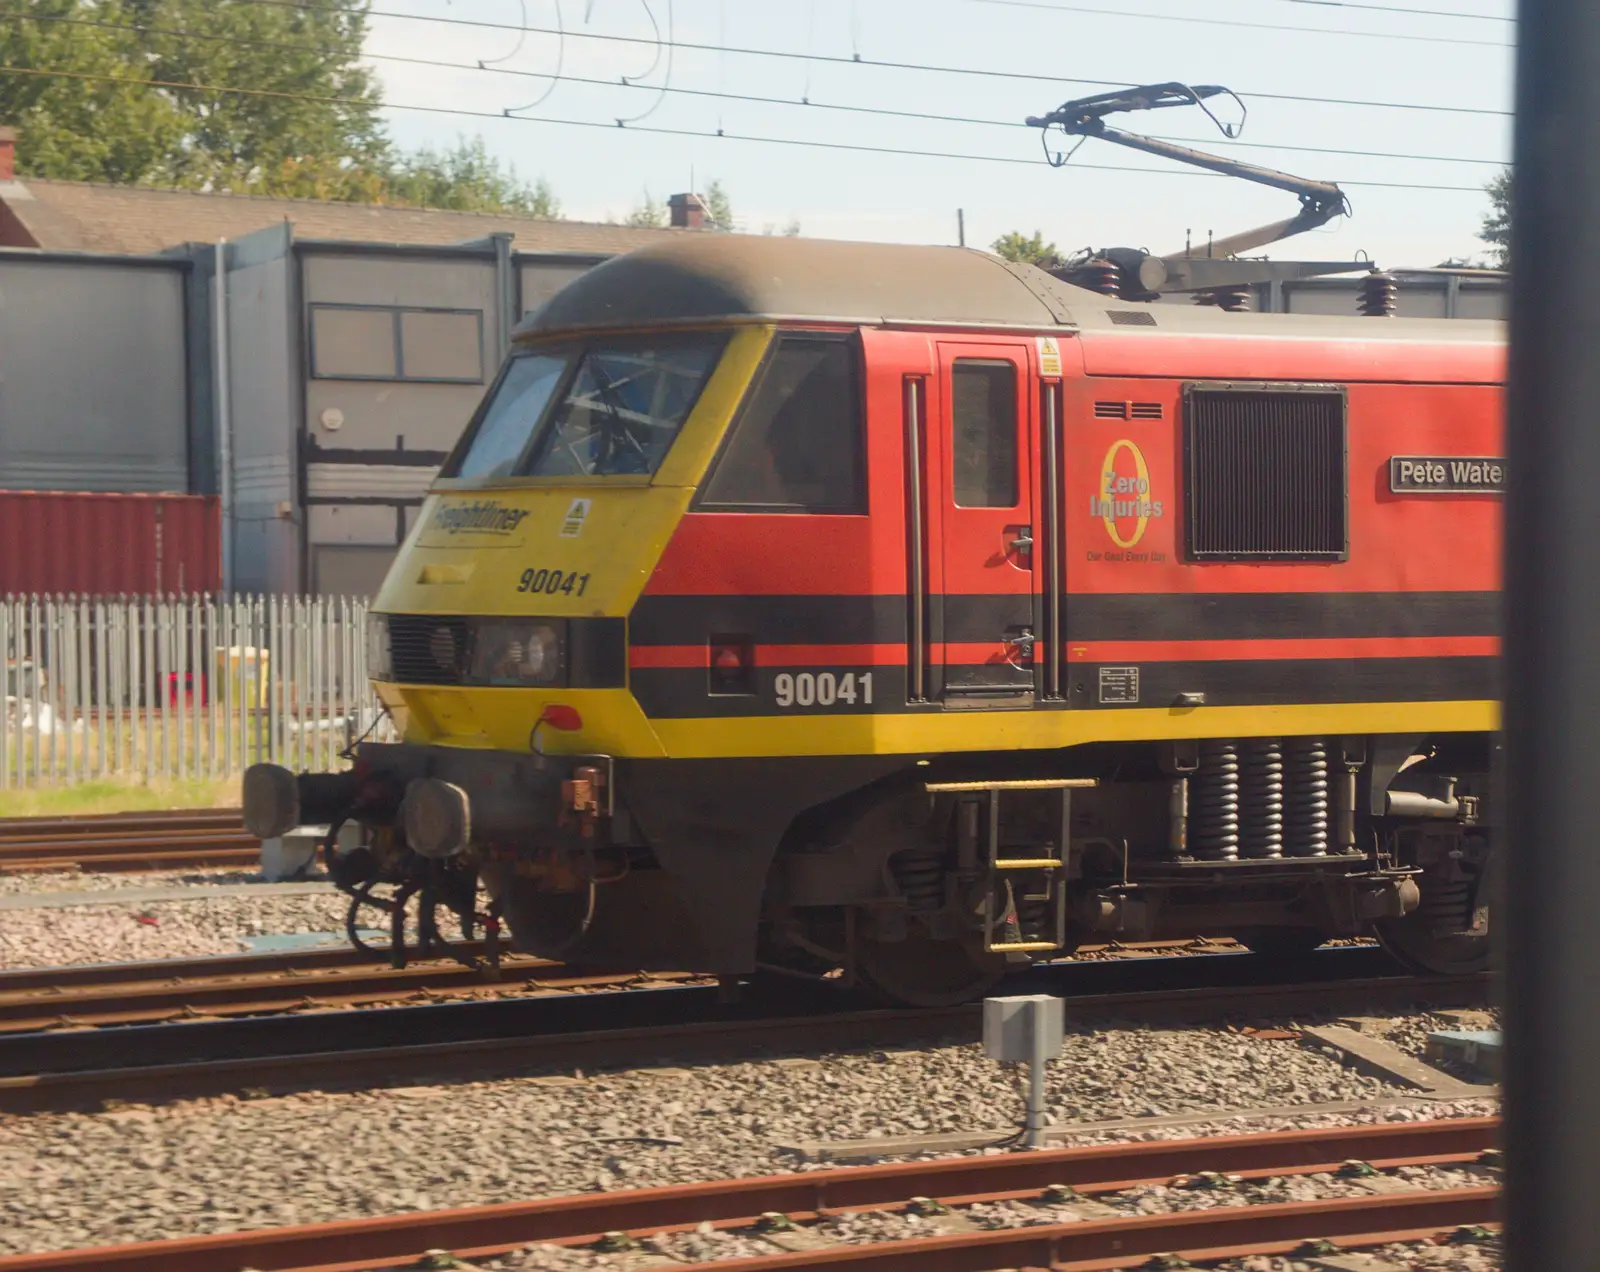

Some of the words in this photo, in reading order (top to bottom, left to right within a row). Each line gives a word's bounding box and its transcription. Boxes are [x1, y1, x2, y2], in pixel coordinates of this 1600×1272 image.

[1103, 472, 1148, 494] Zero
[1399, 460, 1446, 483] Pete
[1450, 460, 1506, 484] Wate
[1089, 495, 1163, 523] Injuries
[517, 568, 591, 597] 90041
[774, 672, 873, 706] 90041
